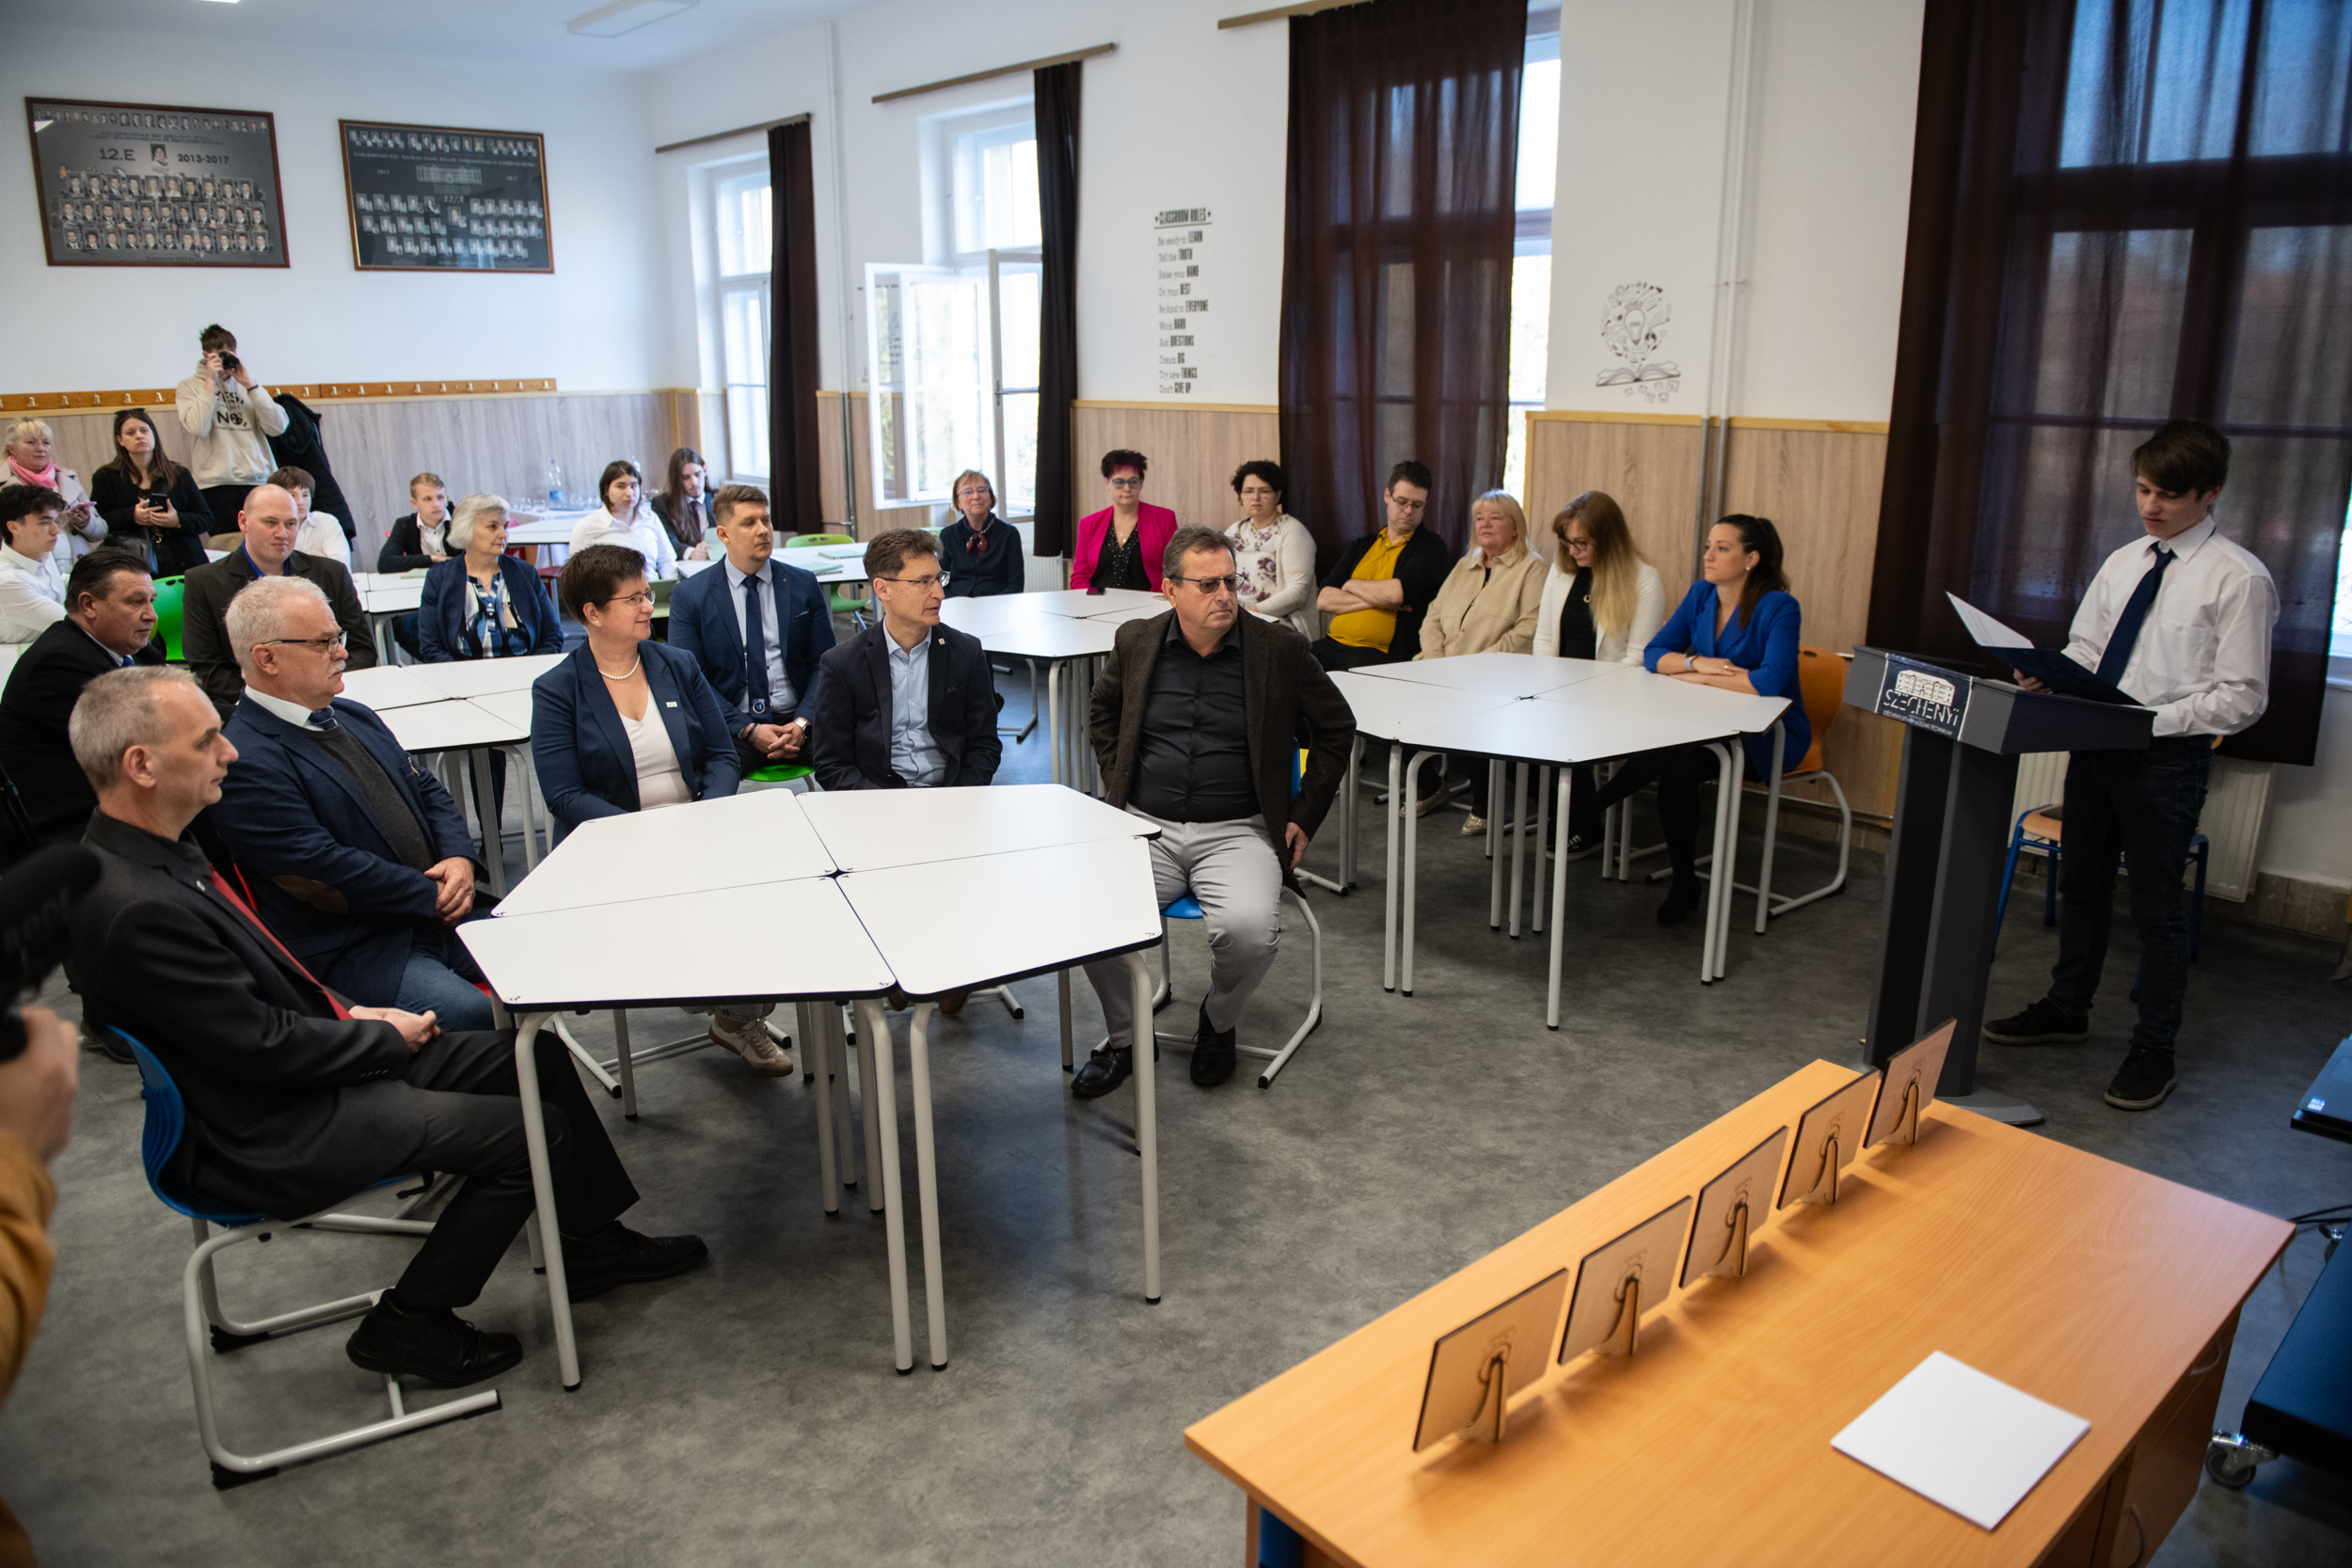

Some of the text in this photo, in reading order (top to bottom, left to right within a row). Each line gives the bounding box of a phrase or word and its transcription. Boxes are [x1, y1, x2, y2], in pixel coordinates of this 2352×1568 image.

[99, 148, 135, 161] 12.E
[177, 153, 230, 165] 2013-2017
[1159, 207, 1206, 225] CLASSROOM RULES
[1158, 236, 1165, 246] Be
[1188, 230, 1203, 243] LEARN
[1178, 248, 1193, 261] TRUTH
[1180, 283, 1191, 295] BEST
[1159, 304, 1166, 313] Be
[1185, 300, 1209, 312] EVERYONE
[1174, 318, 1186, 330] HARD
[1159, 335, 1194, 347] Ask QUESTIONS
[1177, 352, 1185, 364] BIG
[1181, 367, 1198, 379] THINGS
[1174, 382, 1184, 394] GIVE
[1185, 382, 1191, 394] UP
